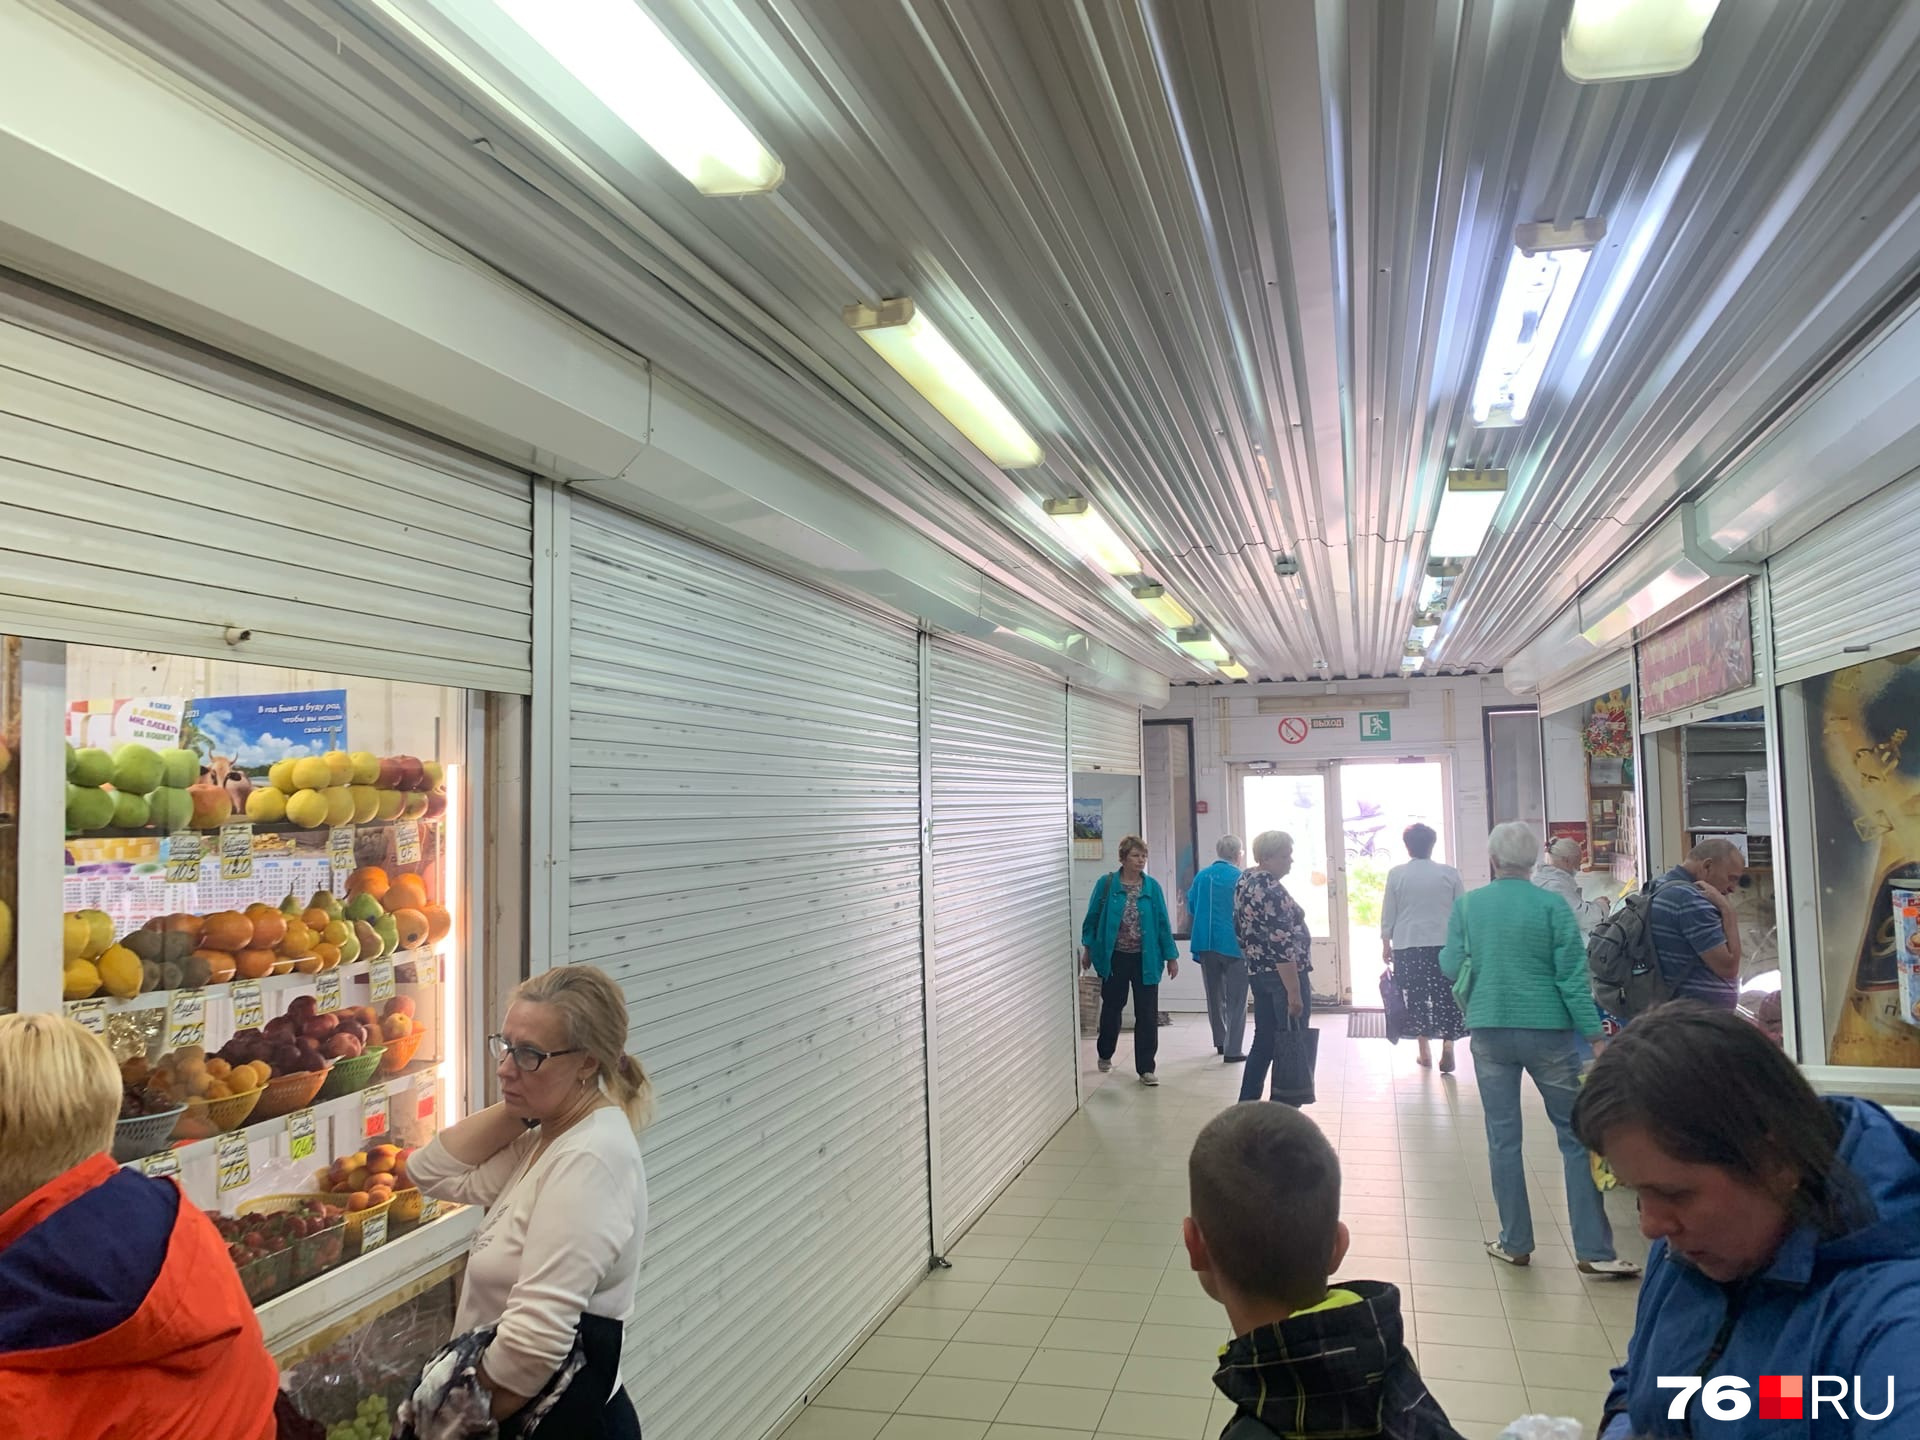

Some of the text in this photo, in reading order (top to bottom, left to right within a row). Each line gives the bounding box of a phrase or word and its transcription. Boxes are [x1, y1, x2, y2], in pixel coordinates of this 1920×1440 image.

[258, 705, 264, 714] В
[264, 706, 278, 714] год
[279, 704, 298, 713] быка
[305, 702, 324, 713] буду
[128, 715, 146, 726] МНЕ
[146, 719, 178, 734] ПЛЕВАТЬ
[282, 714, 305, 723] чтобы
[1312, 719, 1343, 728] ВЫХОД
[171, 861, 200, 881] 105
